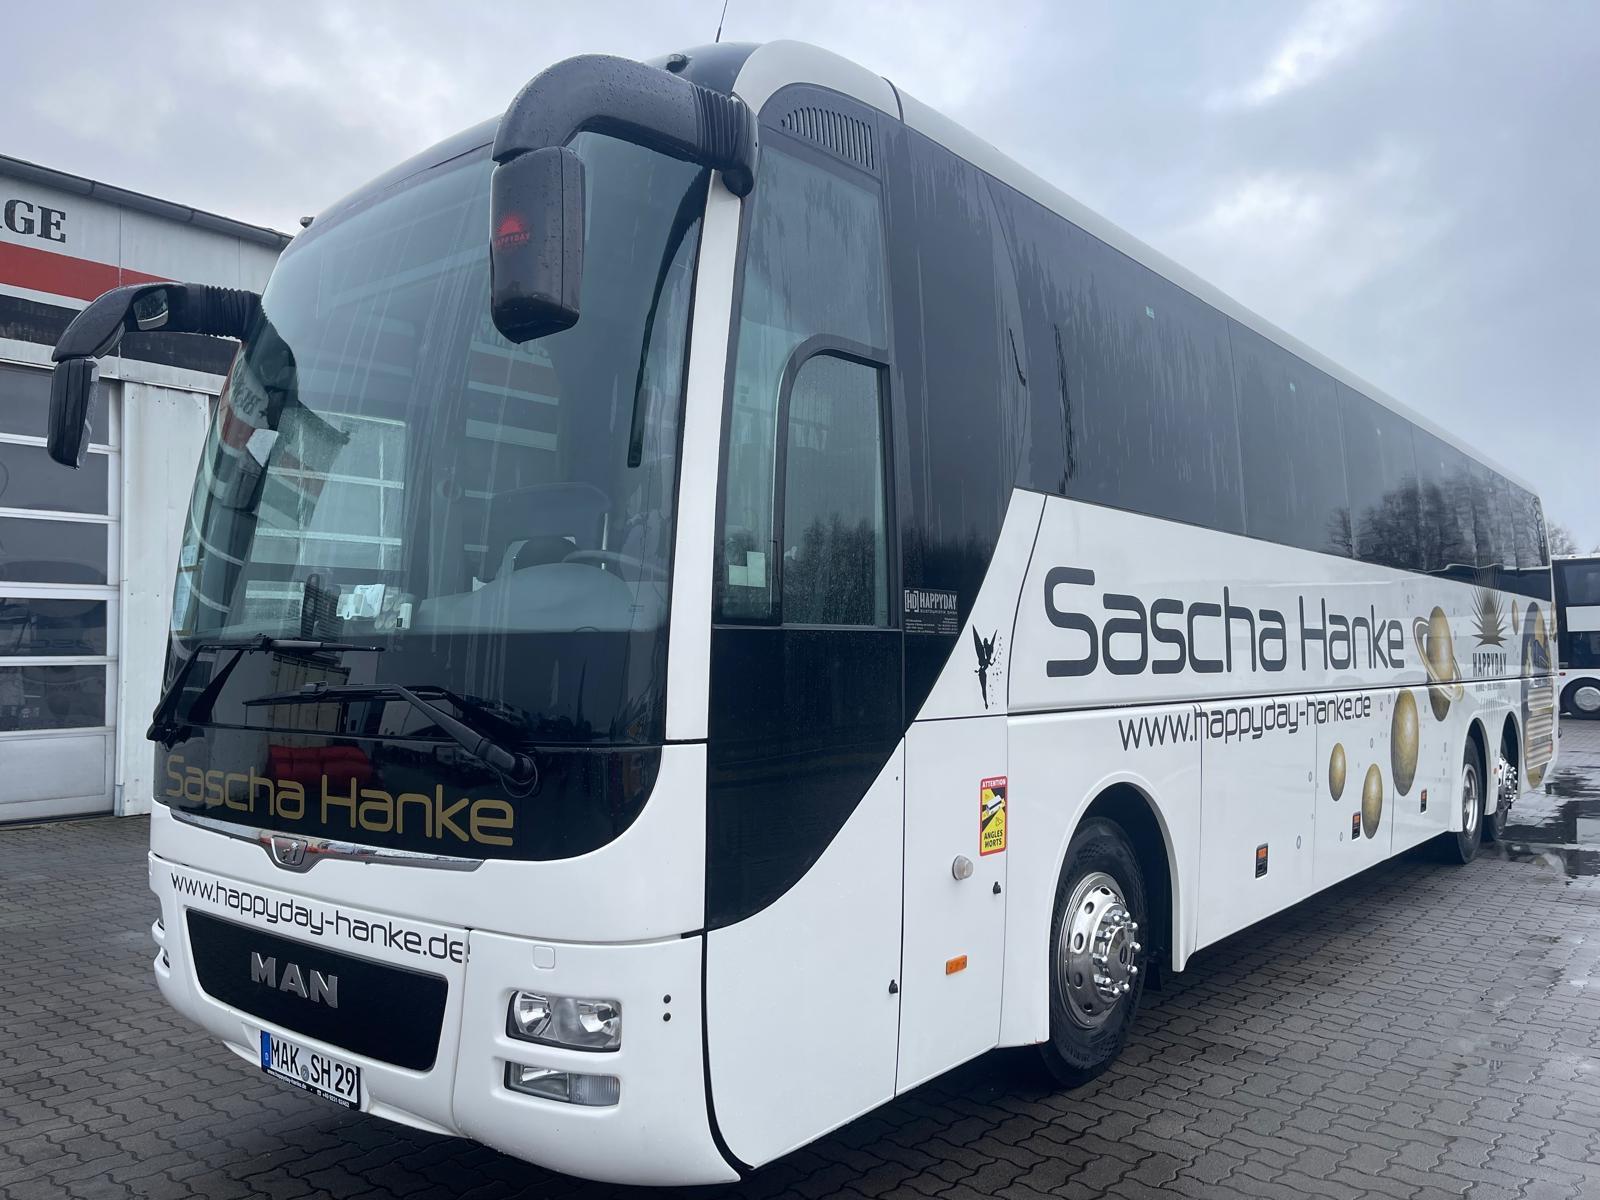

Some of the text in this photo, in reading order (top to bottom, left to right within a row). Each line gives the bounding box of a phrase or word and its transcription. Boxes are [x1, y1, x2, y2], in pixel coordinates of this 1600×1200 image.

[0, 199, 66, 243] GE
[919, 592, 957, 610] HAPPYDAY
[1044, 566, 1405, 677] Sascha Hanke
[1472, 652, 1507, 677] HAPPYDAY
[1118, 695, 1371, 751] www.happyday-hanke.de
[166, 755, 515, 847] Sascha Hanke
[982, 779, 1006, 787] ATTENTION
[985, 830, 1003, 839] ANGLES
[985, 839, 1002, 848] MORTS
[170, 872, 470, 964] www.happyday-hanke.de
[250, 951, 339, 1009] MAN
[271, 1037, 355, 1097] MAK SH 29
